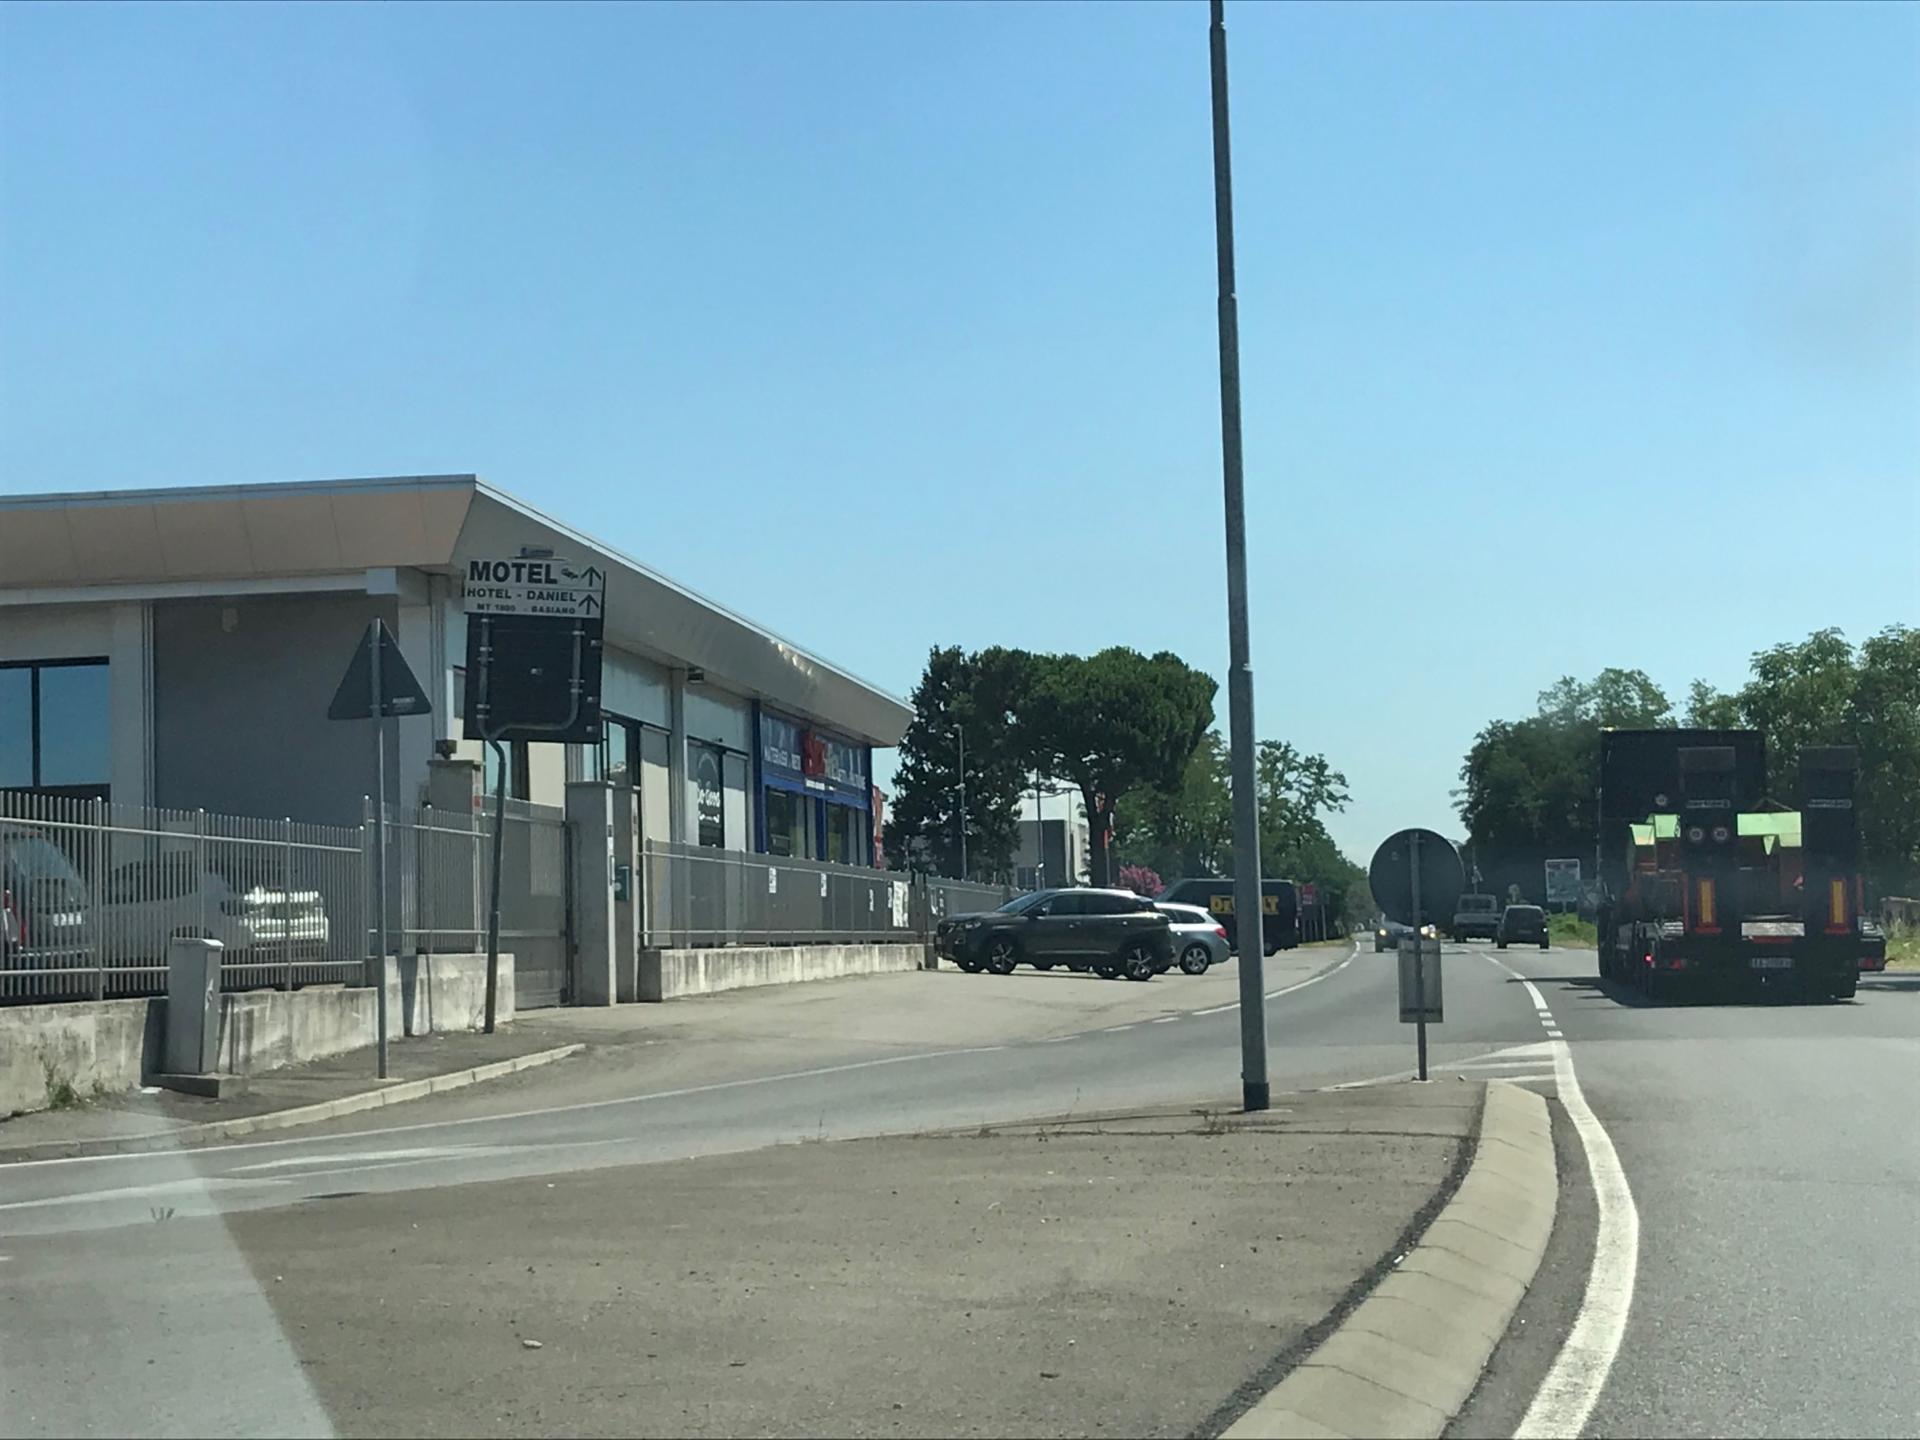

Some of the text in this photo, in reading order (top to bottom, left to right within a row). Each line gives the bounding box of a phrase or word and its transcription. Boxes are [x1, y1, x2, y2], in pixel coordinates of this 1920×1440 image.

[469, 561, 558, 584] MOTEL
[467, 587, 512, 599] HOTEL
[527, 590, 577, 602] DANIEL
